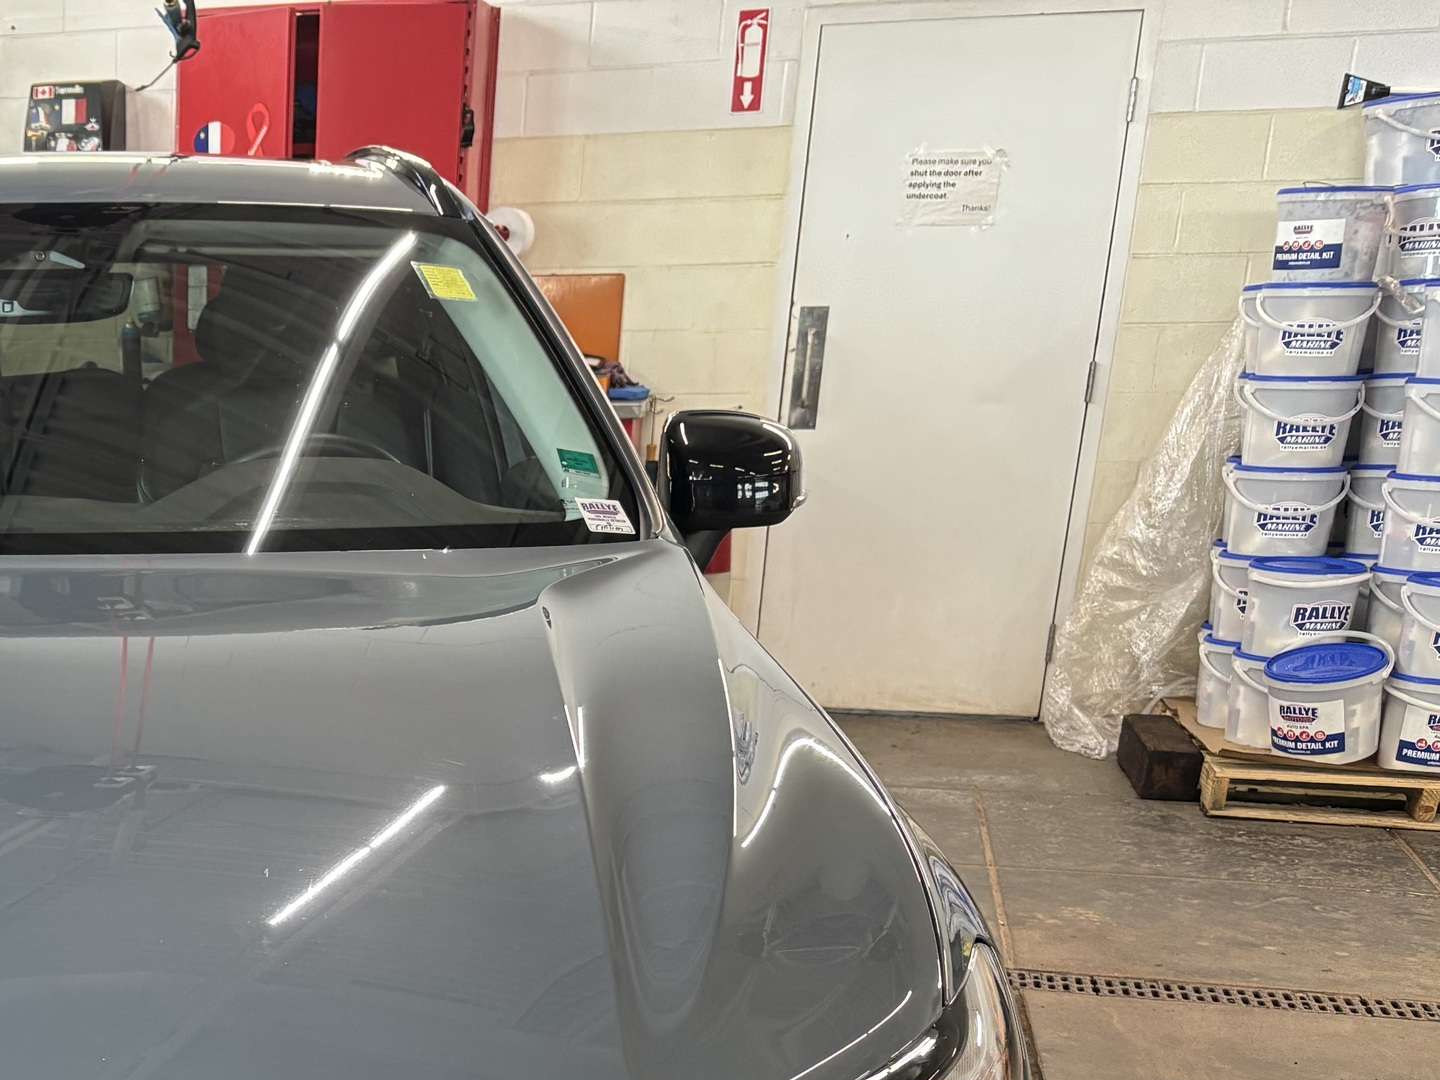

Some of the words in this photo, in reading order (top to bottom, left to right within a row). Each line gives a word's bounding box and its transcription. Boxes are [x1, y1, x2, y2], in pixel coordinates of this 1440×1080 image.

[911, 157, 937, 165] Please
[938, 157, 959, 165] make
[910, 169, 927, 177] shut
[929, 169, 942, 177] the
[943, 169, 961, 177] door
[963, 169, 983, 177] after
[908, 180, 942, 189] applying
[943, 180, 956, 188] the
[1298, 251, 1321, 260] DETAIL
[1322, 251, 1334, 259] KIT
[1290, 340, 1333, 350] MARINE
[1284, 435, 1325, 444] MARINE
[581, 502, 618, 512] RALLYE
[1265, 522, 1307, 532] MARINE
[1293, 605, 1350, 623] RALLYE
[1302, 621, 1341, 631] MARINE
[1279, 705, 1318, 718] RALLYE
[1297, 741, 1323, 750] DETAIL
[1325, 740, 1339, 749] KIT
[1402, 748, 1440, 761] PREMIUM
